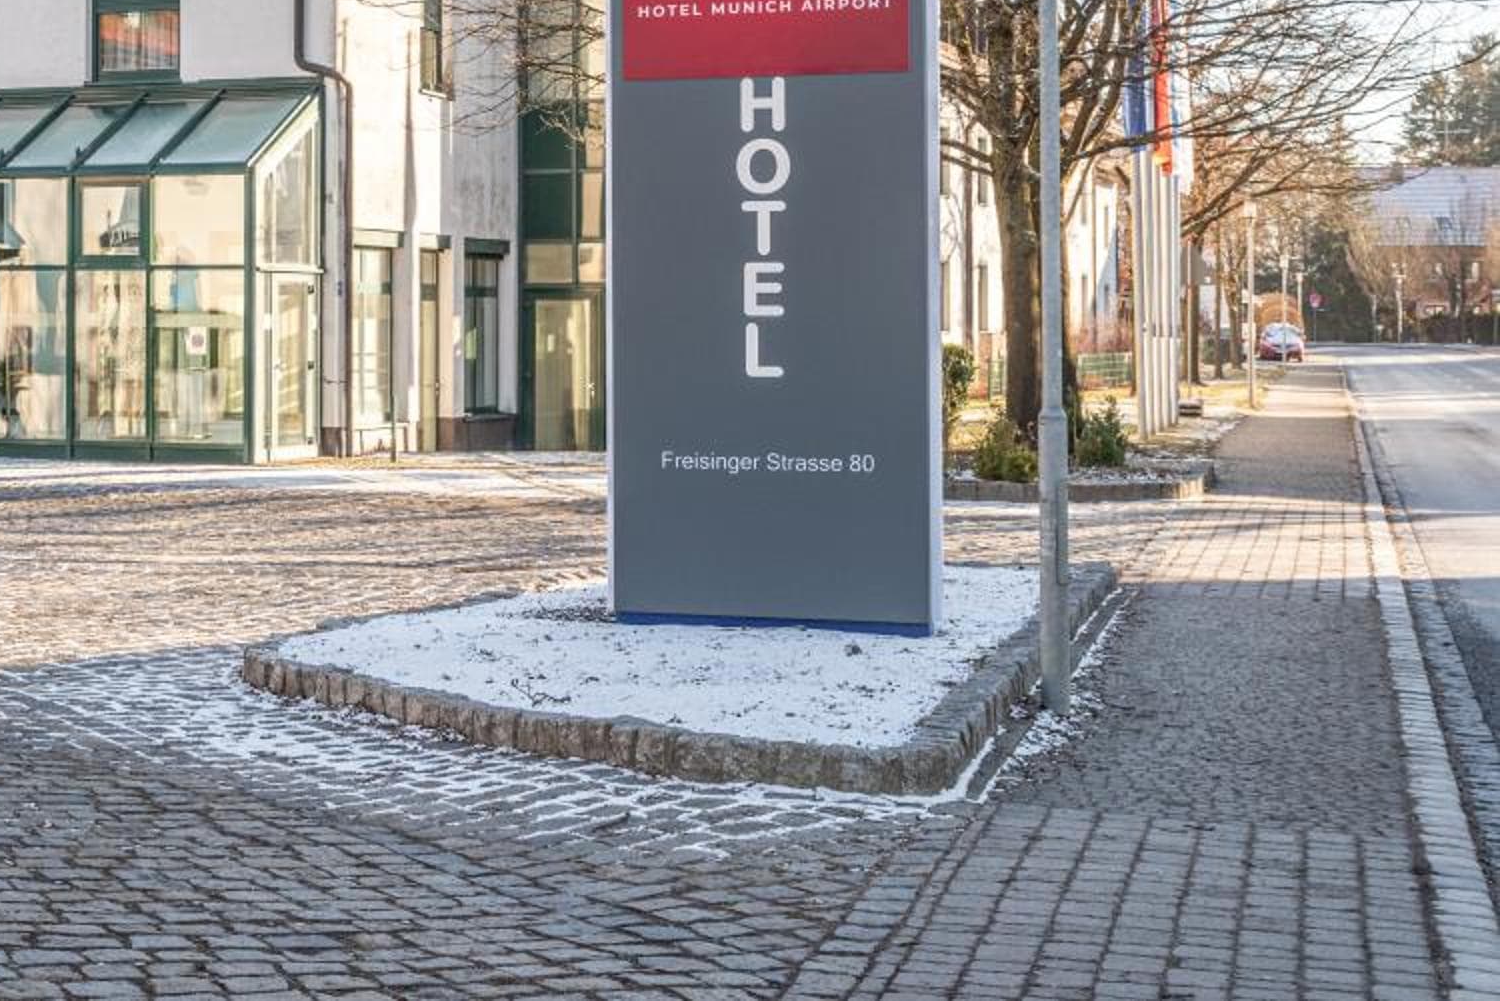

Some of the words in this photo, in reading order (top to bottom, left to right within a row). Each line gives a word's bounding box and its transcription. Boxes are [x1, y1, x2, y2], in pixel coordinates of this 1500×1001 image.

[636, 3, 702, 18] HOTEL
[710, 0, 792, 16] MUNICH
[735, 76, 791, 378] HOTEL
[660, 450, 759, 475] Freisinger
[766, 452, 844, 472] Strasse
[848, 454, 876, 472] 80
